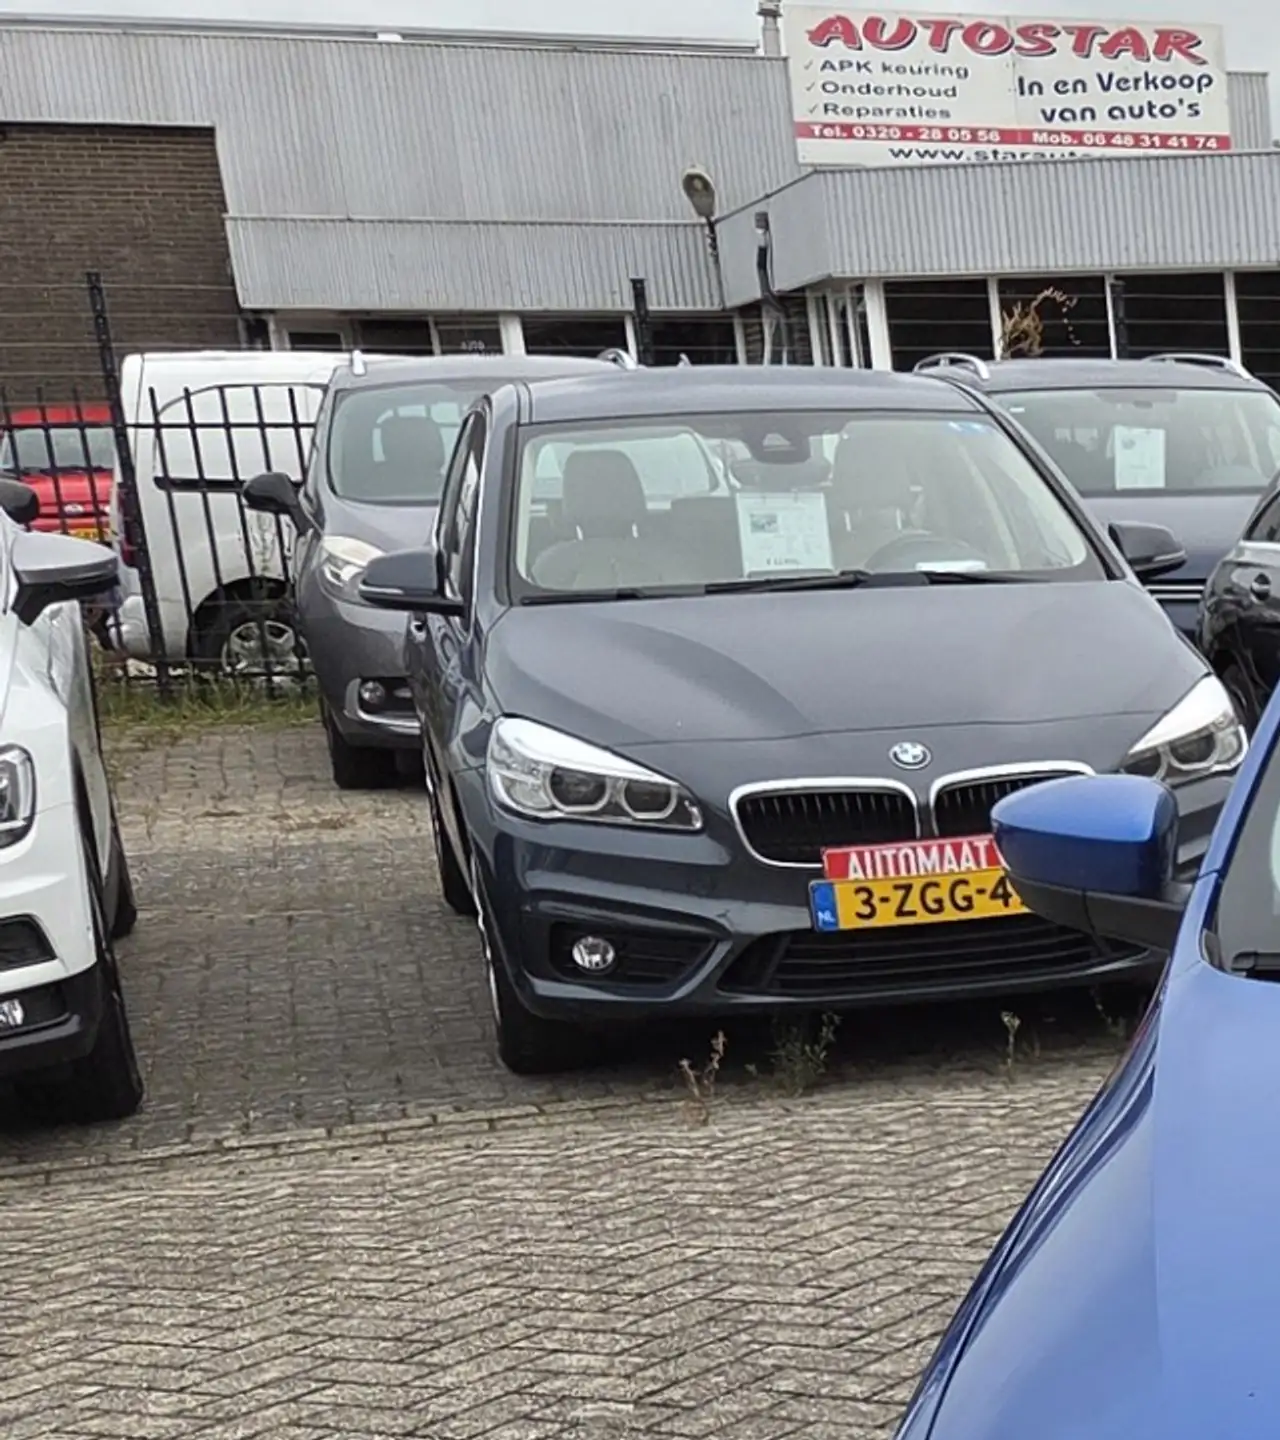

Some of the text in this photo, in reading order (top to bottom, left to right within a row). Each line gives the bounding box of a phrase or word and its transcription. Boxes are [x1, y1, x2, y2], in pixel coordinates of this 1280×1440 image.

[805, 14, 1209, 66] AUTOSTAR
[819, 59, 970, 79] APK keuring
[820, 80, 958, 98] Onderhoud
[1017, 70, 1214, 96] In en Verkoop
[822, 102, 952, 120] Reparaties
[1040, 97, 1201, 123] van auto's
[810, 123, 848, 138] Tel.
[852, 125, 901, 139] 0320
[947, 129, 973, 142] 05
[1031, 130, 1079, 145] Mob.
[1139, 134, 1161, 147] 31
[1166, 135, 1189, 148] 41
[1194, 136, 1218, 149] 74
[847, 840, 990, 881] AUTOMAAT
[853, 876, 1014, 921] 3-ZGG-4
